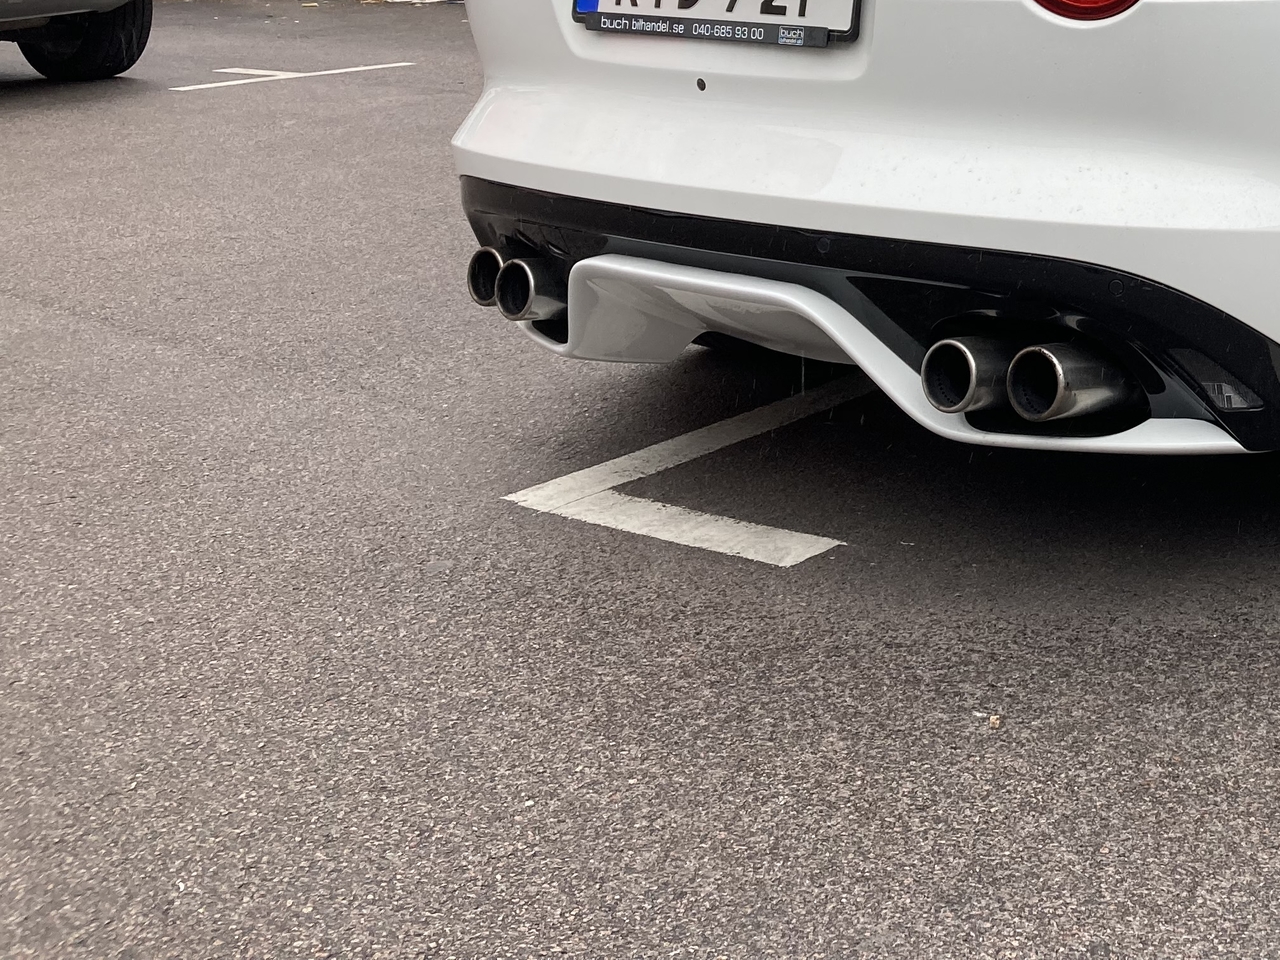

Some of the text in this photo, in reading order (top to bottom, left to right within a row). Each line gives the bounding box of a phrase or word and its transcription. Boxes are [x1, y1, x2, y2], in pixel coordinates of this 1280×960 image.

[601, 16, 764, 40] buch bilhandel.se 040-685 93 00
[780, 28, 803, 38] buch
